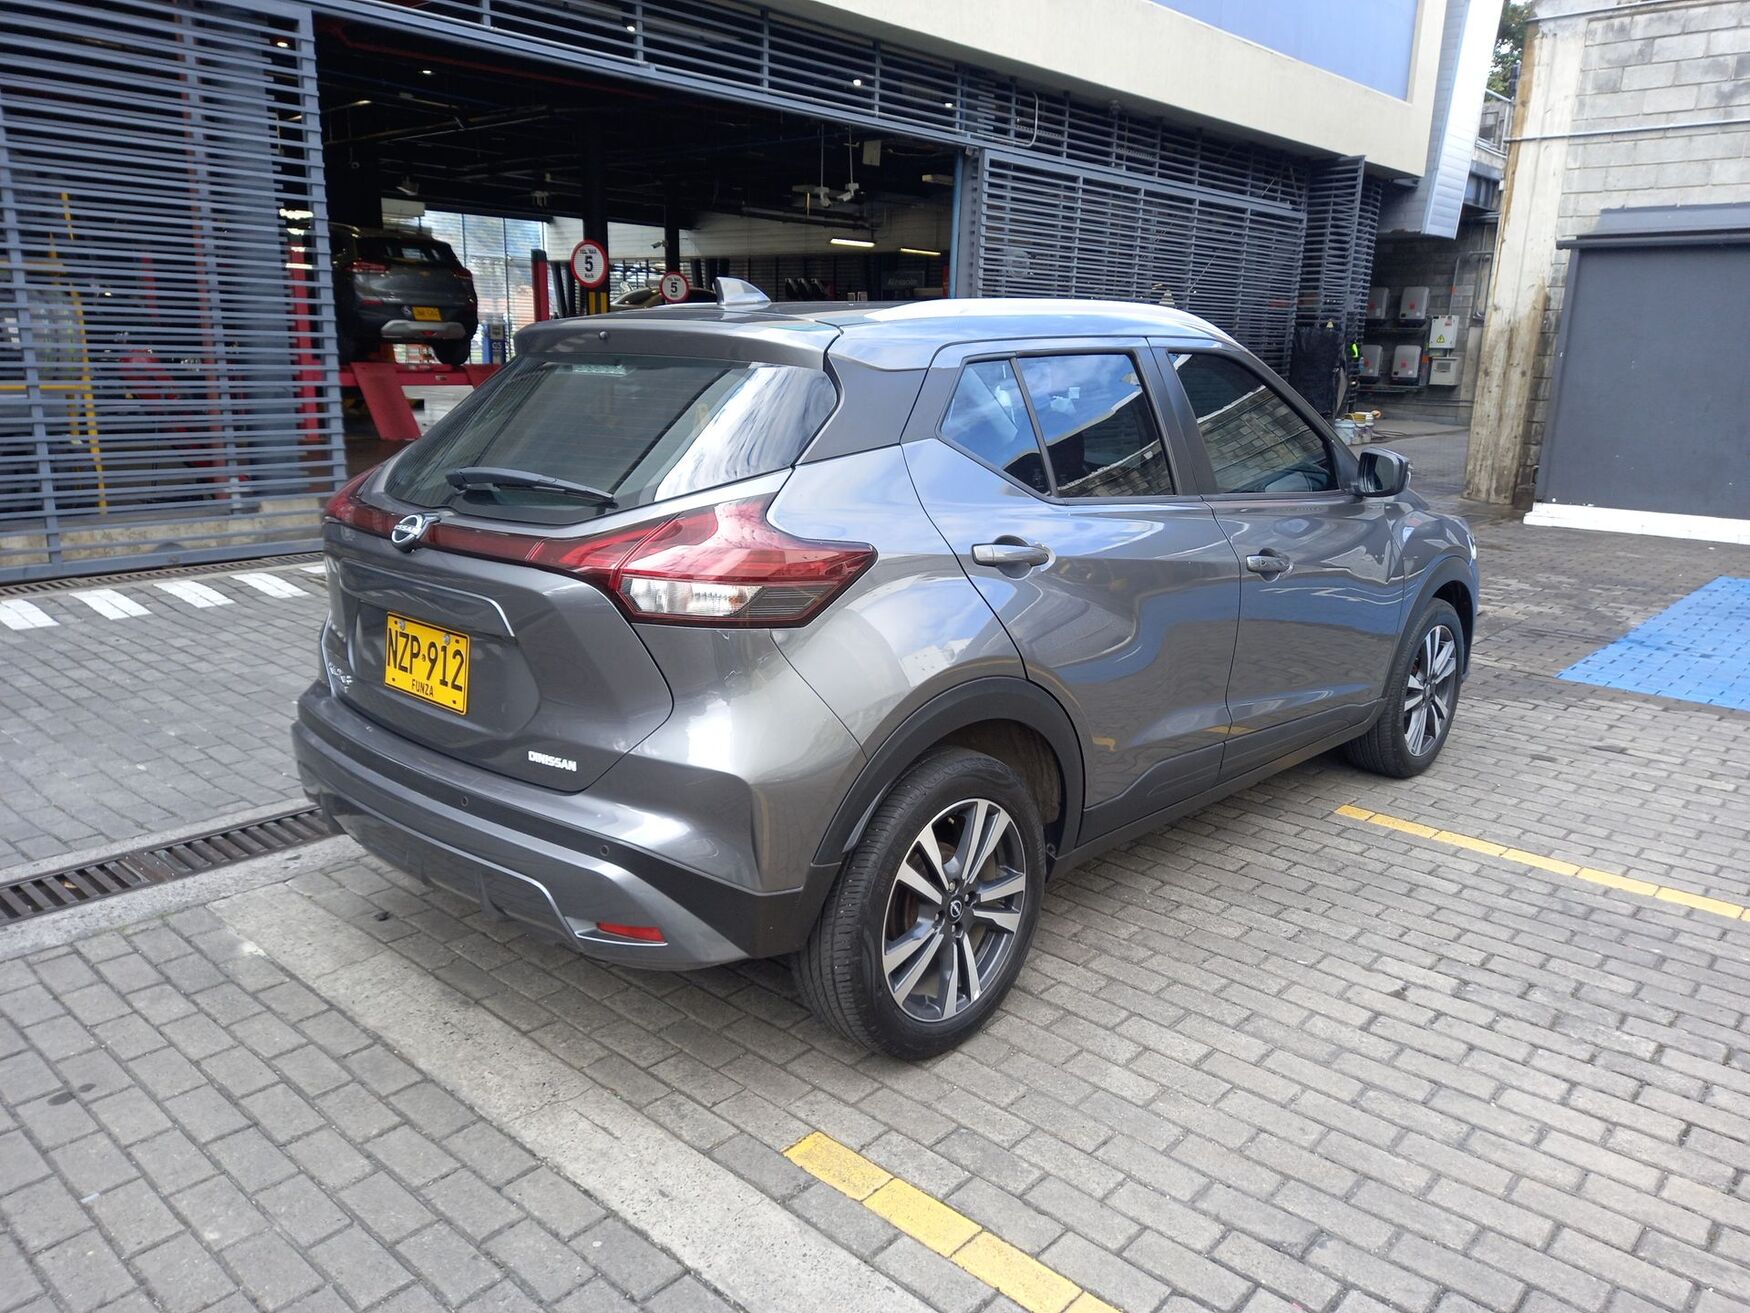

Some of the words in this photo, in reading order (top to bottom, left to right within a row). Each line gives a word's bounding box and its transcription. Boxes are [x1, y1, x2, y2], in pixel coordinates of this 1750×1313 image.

[584, 254, 594, 272] 5
[670, 281, 678, 294] 5
[411, 678, 435, 698] FUNZA
